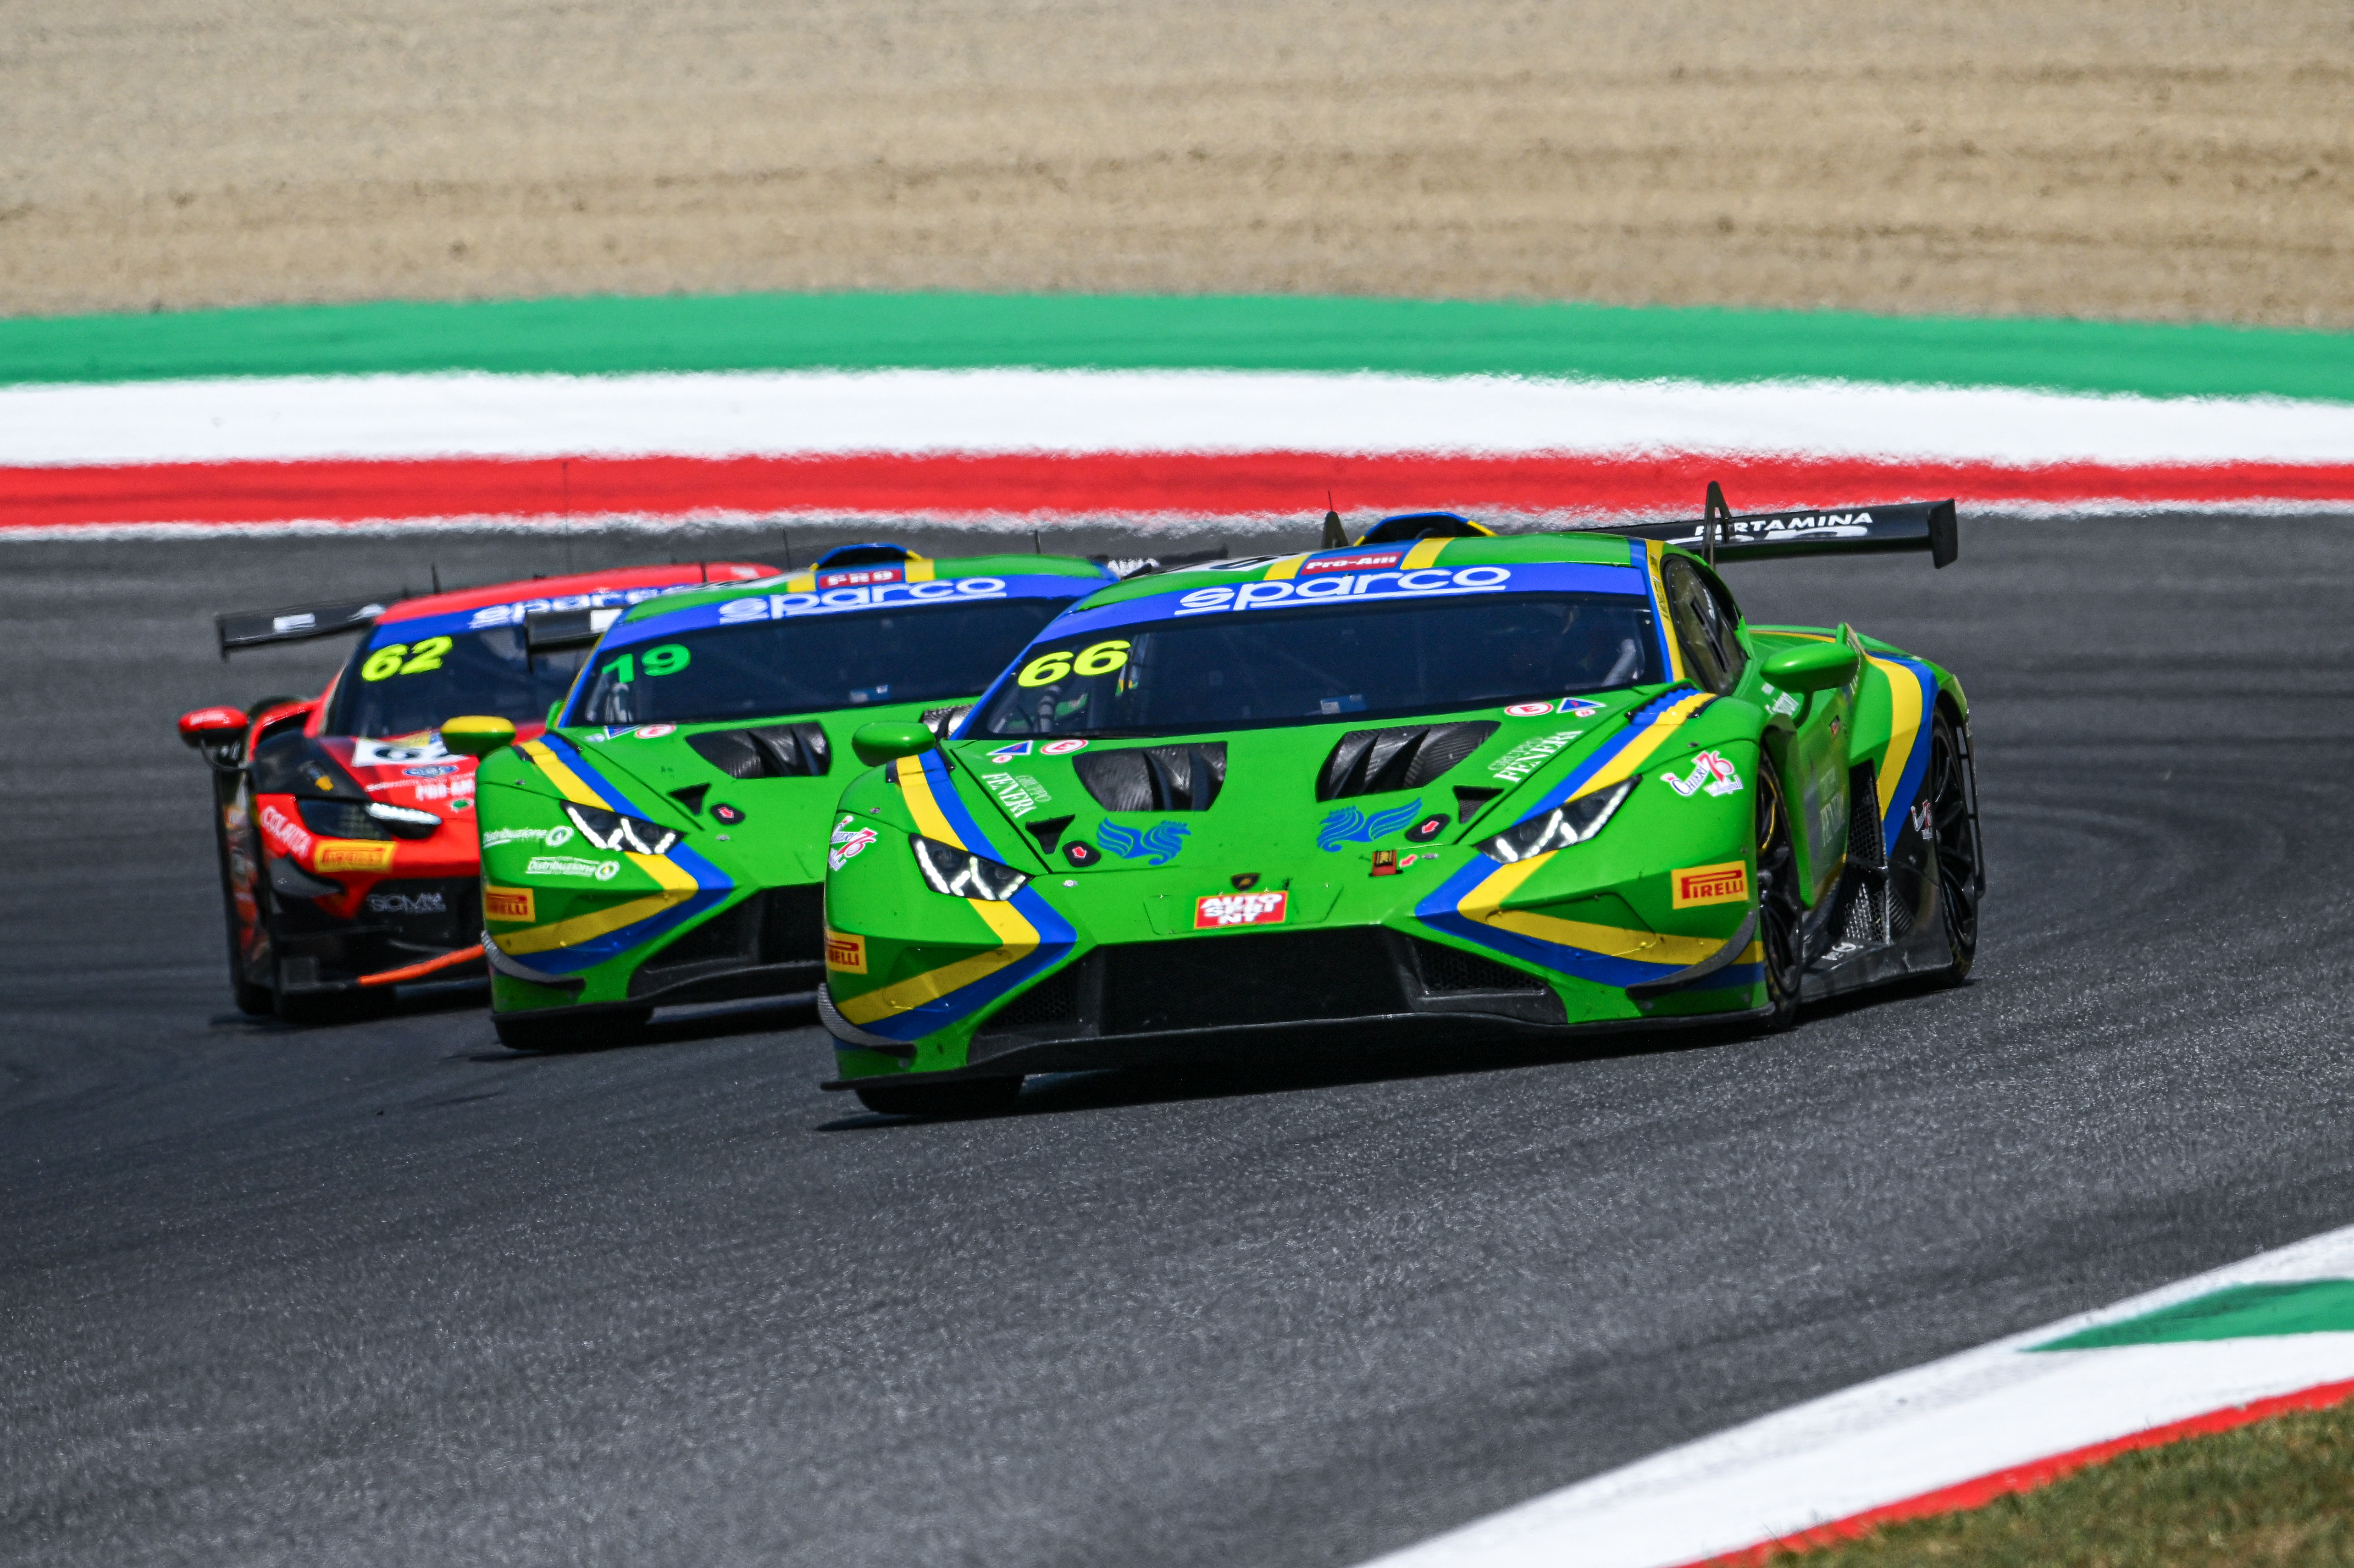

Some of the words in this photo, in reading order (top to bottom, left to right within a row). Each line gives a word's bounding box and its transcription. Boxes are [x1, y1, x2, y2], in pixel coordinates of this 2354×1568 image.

[1695, 512, 1872, 536] PRTAMINA
[719, 577, 1007, 624] sparco
[828, 571, 892, 586] PRO
[1174, 567, 1512, 615] sparco
[361, 636, 453, 681] 62
[602, 644, 691, 683] 19
[1018, 640, 1131, 687] 66
[981, 772, 1037, 818] FENERA
[1681, 870, 1744, 899] PIRELLI
